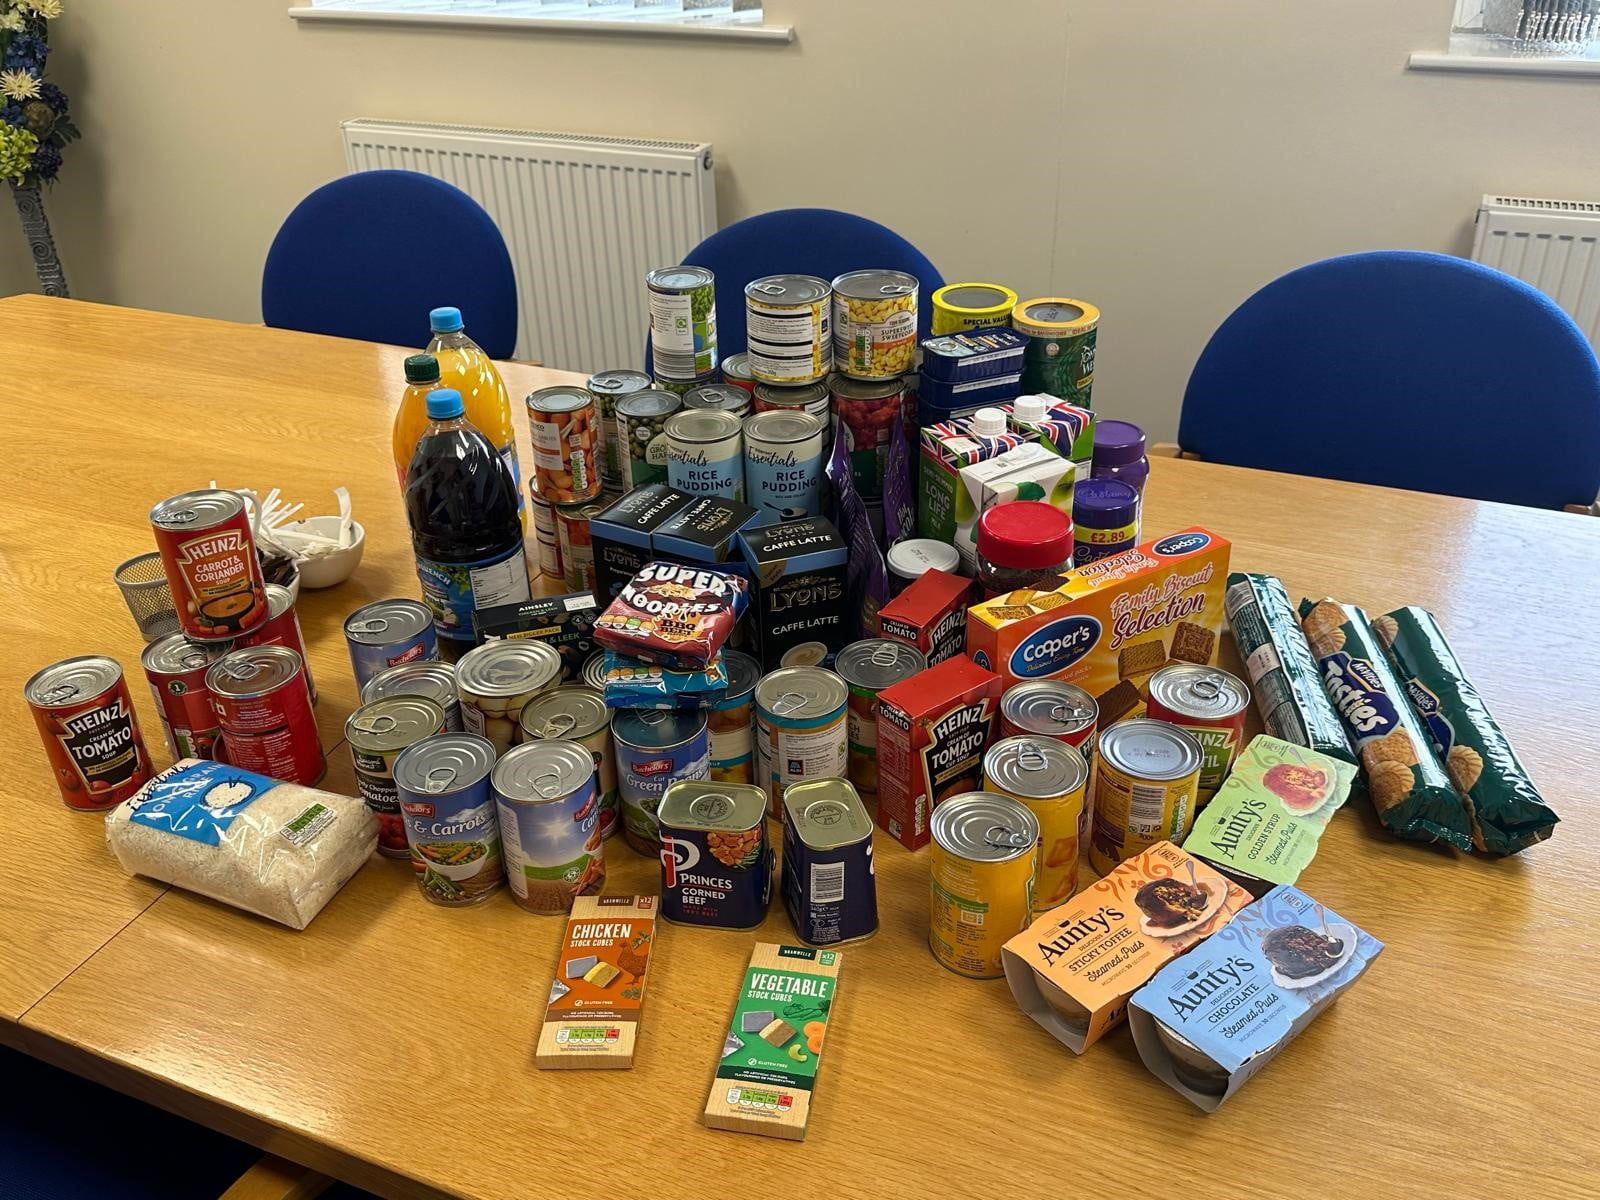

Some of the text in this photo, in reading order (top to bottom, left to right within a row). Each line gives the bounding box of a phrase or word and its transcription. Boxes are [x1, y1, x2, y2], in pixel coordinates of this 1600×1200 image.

[993, 316, 1012, 324] VALU
[677, 478, 732, 491] PUDDING
[689, 471, 718, 481] RICE
[762, 477, 816, 492] PUDDING
[776, 470, 805, 482] RICE
[926, 481, 950, 510] LONG
[638, 507, 660, 524] CAFFE
[657, 493, 680, 510] LATTE
[929, 497, 946, 520] LIFE
[189, 537, 237, 560] HEINZ
[763, 535, 832, 552] CAFFE LATTE
[1091, 531, 1125, 543] £2.89
[195, 563, 244, 583] CORIANDER
[196, 555, 241, 573] CARROT &
[1080, 549, 1145, 577] Selection
[635, 564, 727, 597] SUPER
[1112, 563, 1213, 618] Family Biscuit
[519, 602, 553, 612] AINSLEY
[662, 620, 696, 630] BBQ
[773, 616, 839, 635] CAFFE LATTE
[882, 622, 917, 640] TOMATO
[933, 611, 963, 644] HEINZ
[1111, 593, 1205, 648] Selection
[560, 632, 580, 641] LEEK
[1023, 626, 1090, 662] Cooper's
[929, 635, 962, 668] TOMATO
[1325, 660, 1389, 732] Tasties
[71, 705, 119, 734] HEINZ
[880, 706, 909, 730] TOMATO
[936, 706, 981, 740] HEINZ
[72, 726, 131, 760] TOMATO
[89, 733, 108, 743] CREAM
[101, 751, 116, 760] SOUP
[932, 731, 983, 769] TOMATO
[956, 752, 970, 763] SOUP
[627, 774, 663, 791] Green
[414, 815, 486, 836] & Carrots
[1210, 799, 1267, 861] Aunty's
[1248, 813, 1280, 860] GOLDEN SYRUP
[680, 873, 732, 889] PRINCES
[682, 887, 725, 899] CORNED
[682, 895, 706, 905] BEEF
[572, 924, 632, 939] CHICKEN
[592, 939, 613, 947] CUBES
[1037, 905, 1125, 967] Aunty's
[1068, 927, 1133, 972] STICKY TOFFEE
[1083, 940, 1145, 982] Steamed Puds
[747, 990, 792, 1002] STOCK CUBES
[750, 972, 829, 998] VEGETABLE
[1167, 955, 1255, 1023] Aunty's
[1208, 983, 1260, 1024] CHOCOLATE
[1219, 993, 1279, 1038] Steamed Puds
